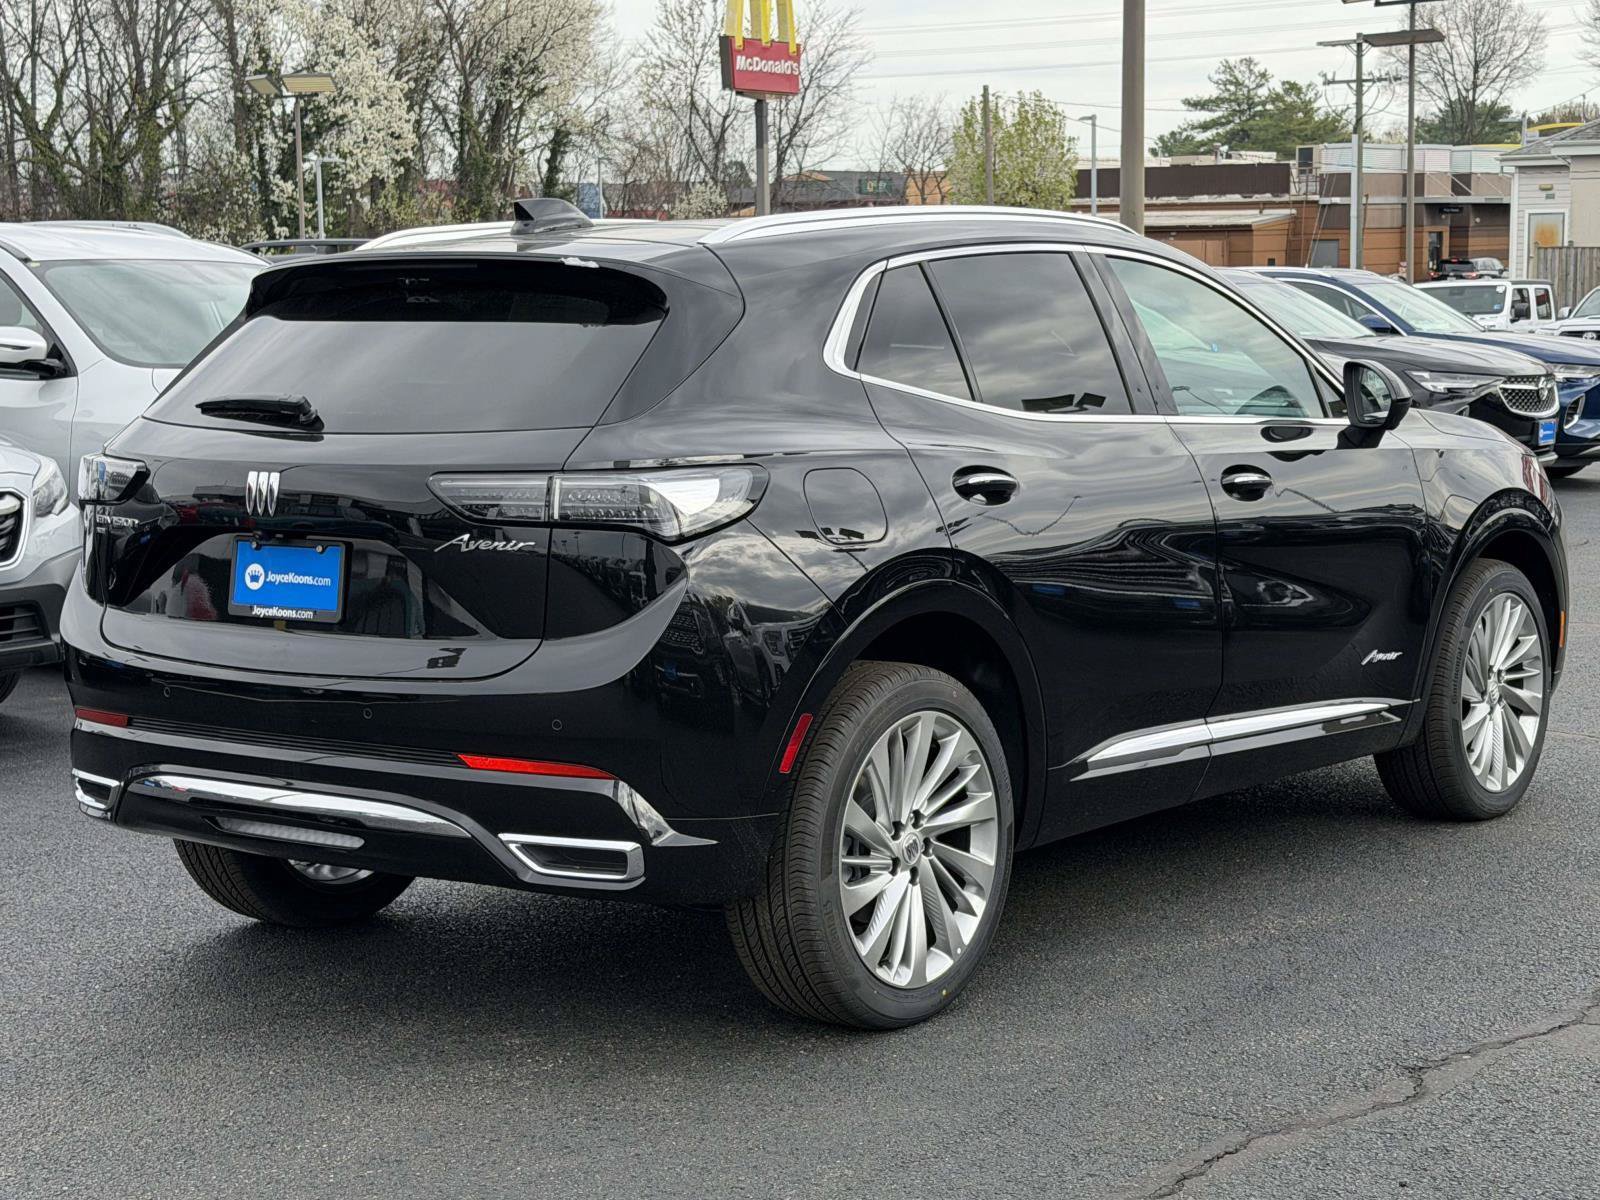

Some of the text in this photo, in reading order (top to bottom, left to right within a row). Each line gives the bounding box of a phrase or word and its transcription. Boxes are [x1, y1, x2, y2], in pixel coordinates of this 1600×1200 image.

[736, 55, 799, 75] McDonald's
[434, 533, 536, 553] Avenir
[266, 571, 331, 587] JoyceKoons.com
[252, 605, 314, 619] JoyceKoons.com
